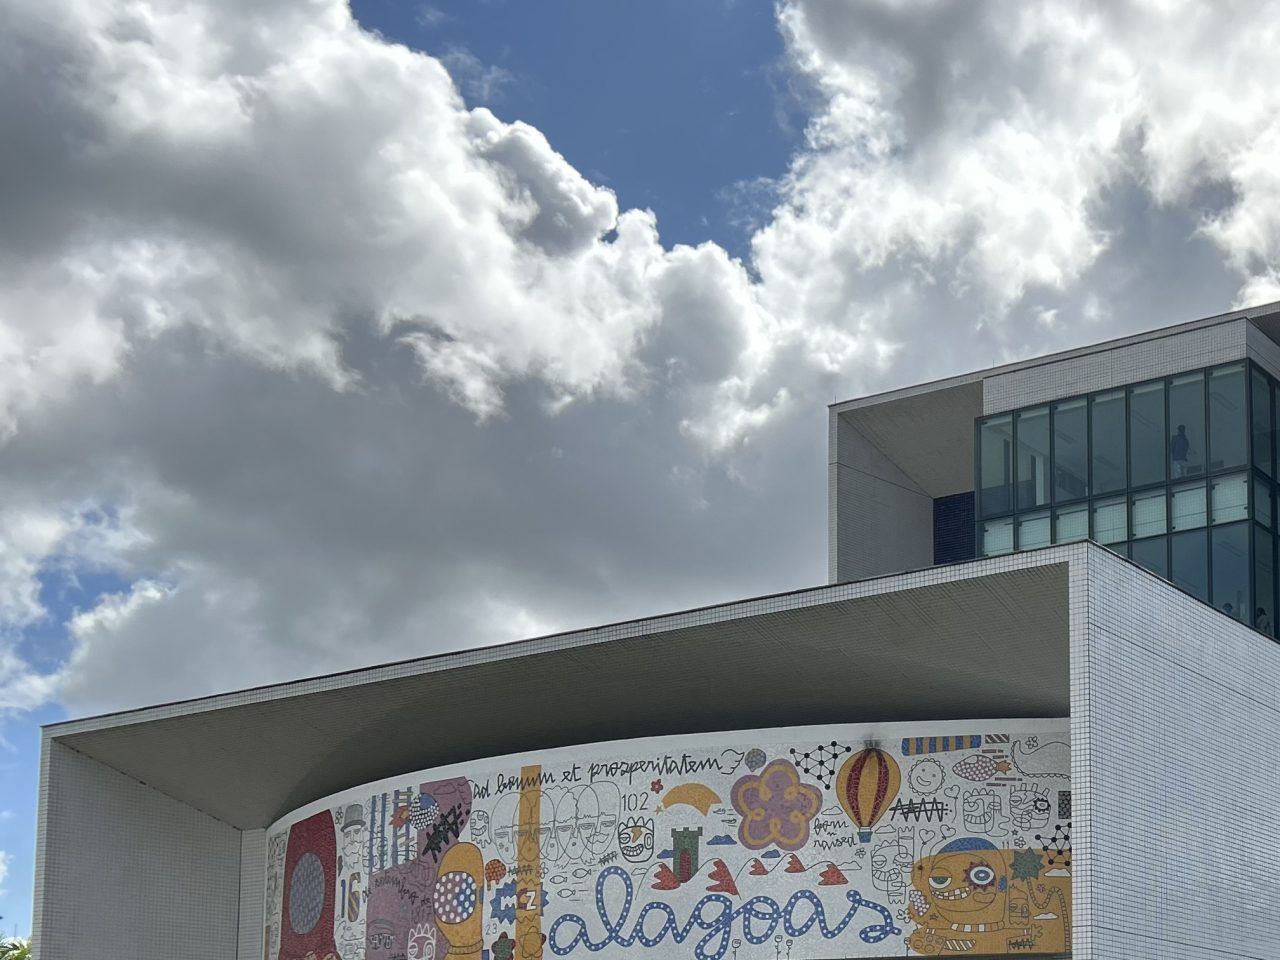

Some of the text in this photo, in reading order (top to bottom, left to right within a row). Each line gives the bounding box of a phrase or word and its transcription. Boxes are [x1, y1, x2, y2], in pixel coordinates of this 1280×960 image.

[473, 778, 491, 800] ad
[494, 773, 556, 796] bonum
[561, 763, 582, 783] et
[621, 792, 650, 812] 102
[341, 871, 361, 922] 16
[485, 922, 498, 936] 23
